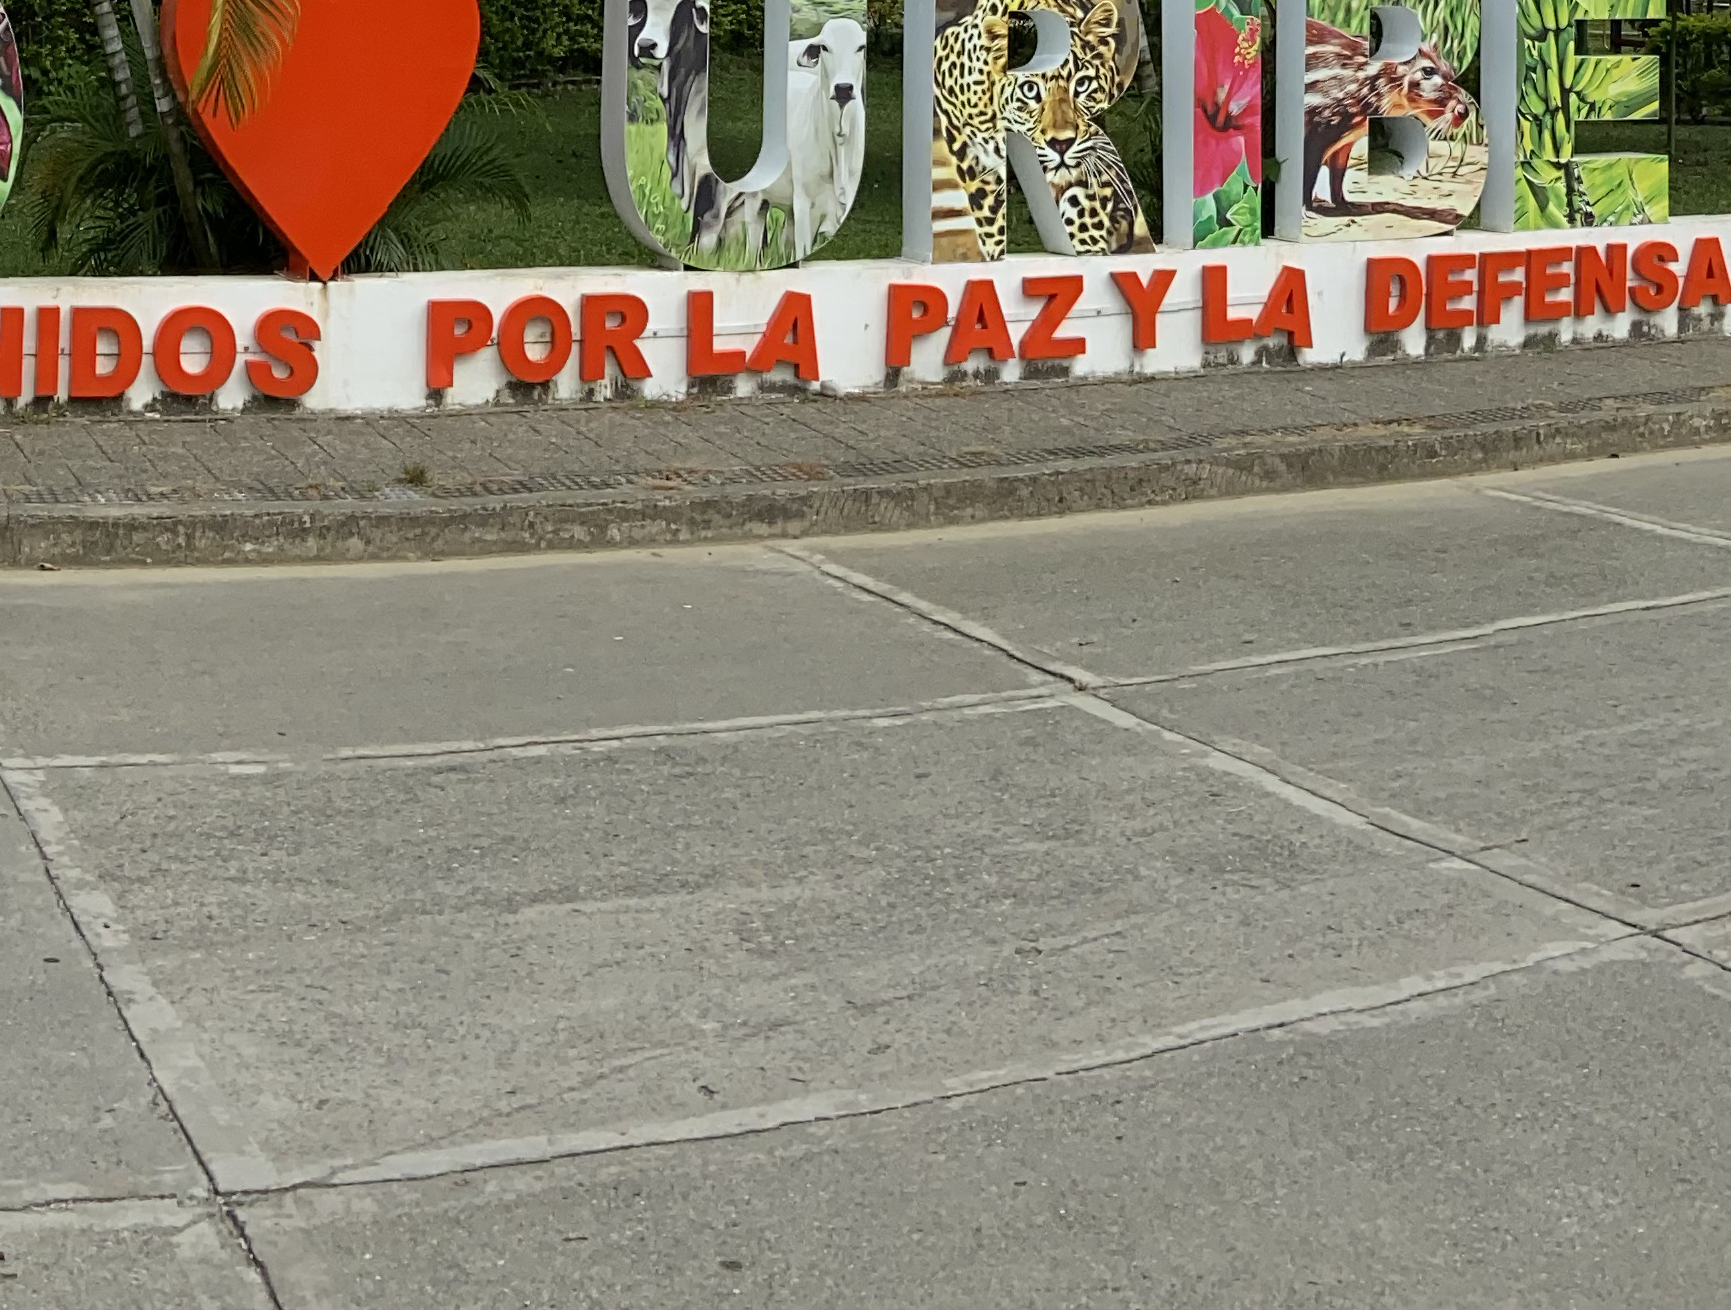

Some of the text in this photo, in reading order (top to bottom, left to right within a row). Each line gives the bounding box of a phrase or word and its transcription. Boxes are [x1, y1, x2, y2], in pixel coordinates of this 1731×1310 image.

[426, 292, 652, 391] POR
[686, 291, 820, 382] LA
[884, 275, 1086, 367] PAZ
[1112, 269, 1176, 352] Y
[1200, 265, 1312, 349] LA
